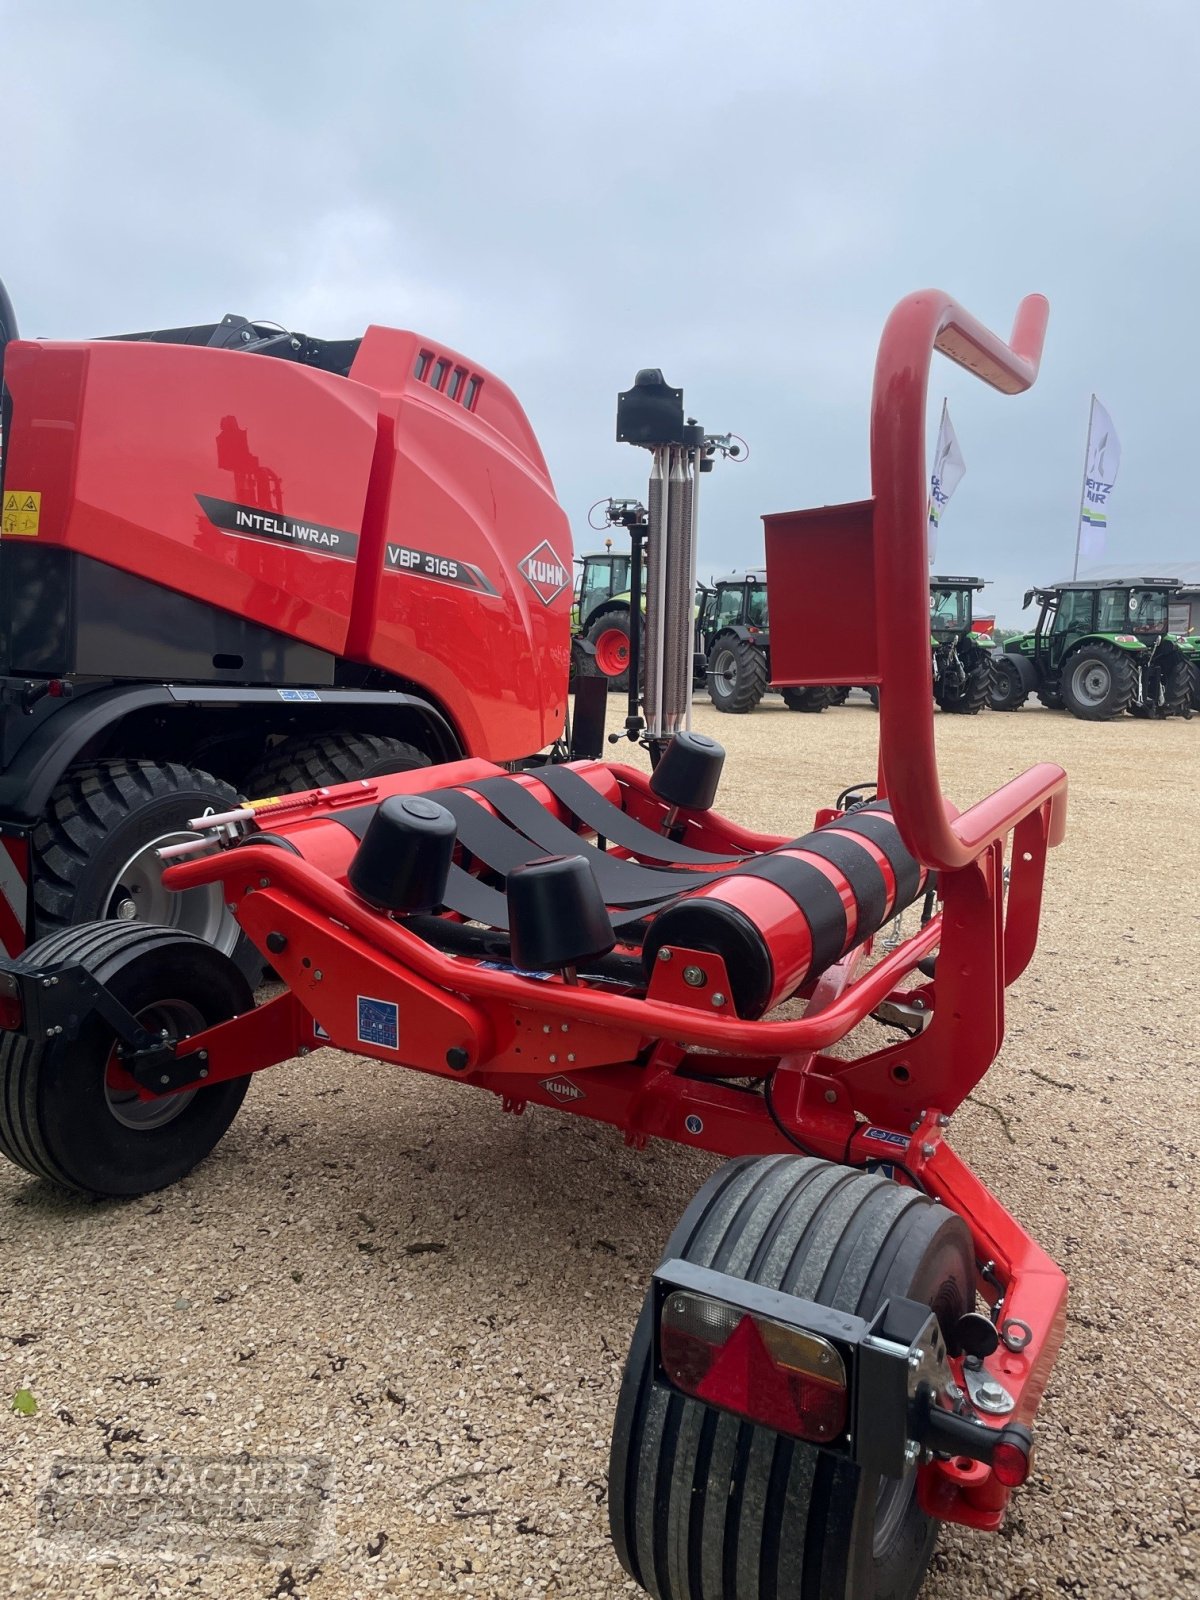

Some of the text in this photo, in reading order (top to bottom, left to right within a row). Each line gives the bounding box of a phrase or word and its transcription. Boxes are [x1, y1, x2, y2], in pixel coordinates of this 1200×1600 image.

[236, 510, 340, 547] INTELLIWRAP
[387, 545, 458, 579] VBP 3165
[528, 558, 564, 587] KUHN
[546, 1081, 578, 1098] KUHN
